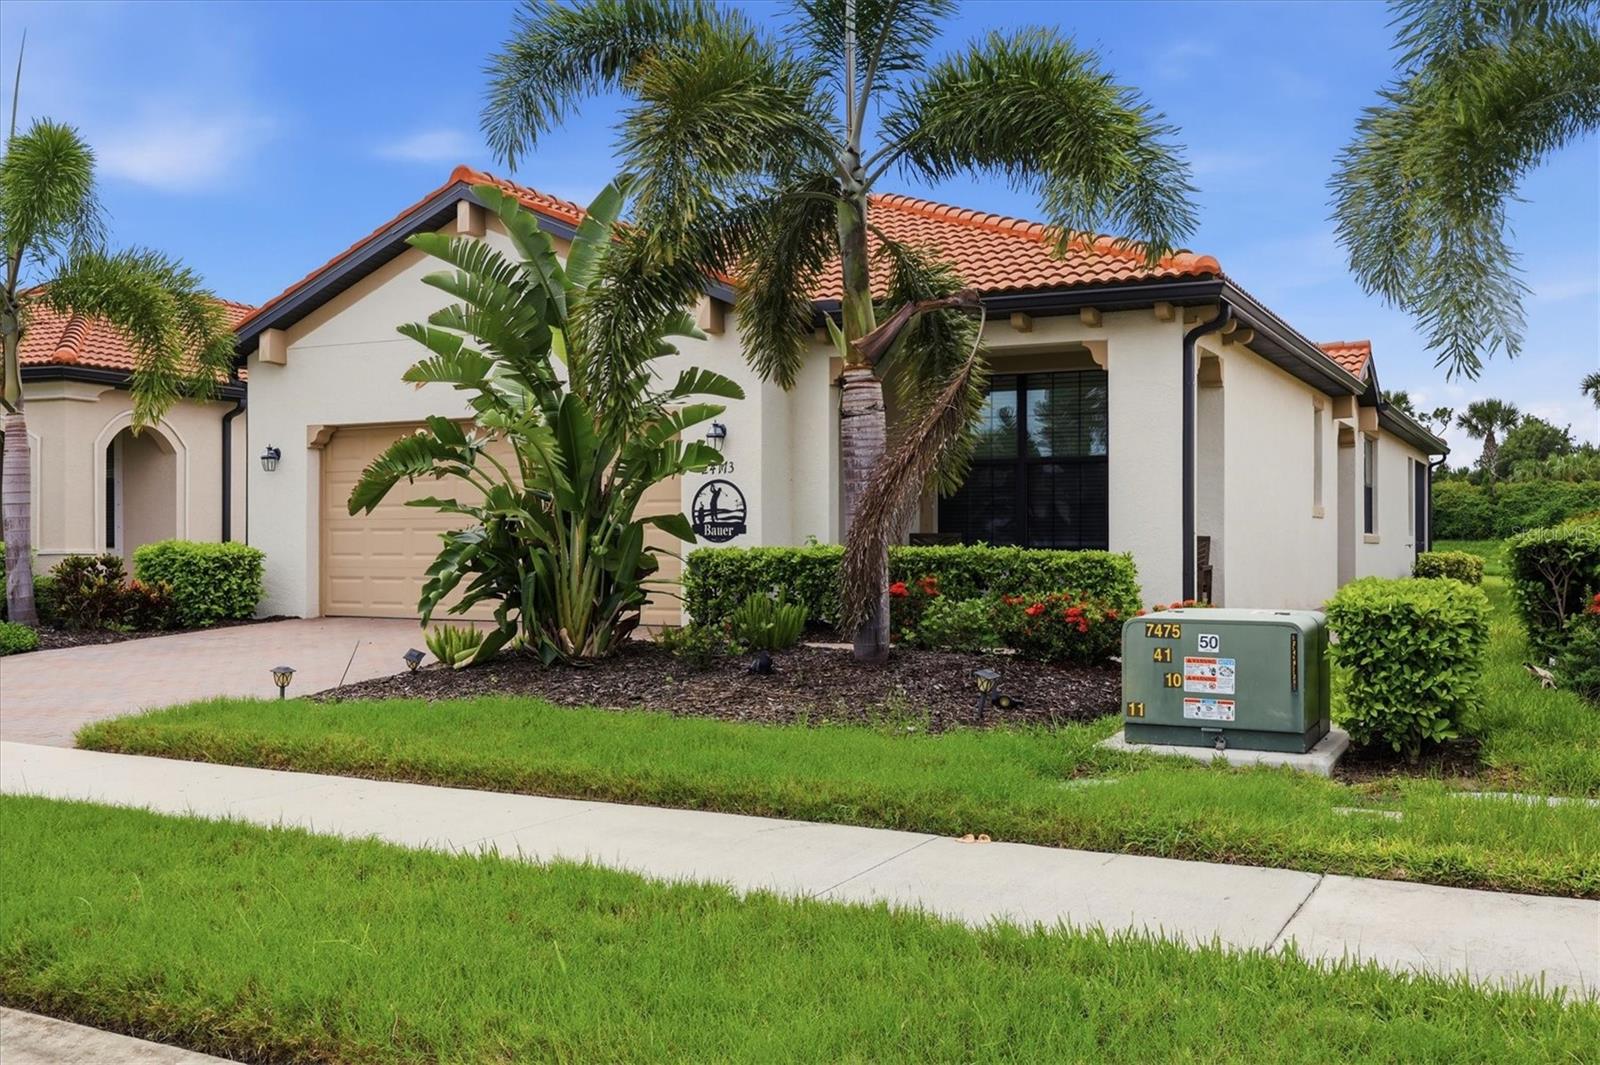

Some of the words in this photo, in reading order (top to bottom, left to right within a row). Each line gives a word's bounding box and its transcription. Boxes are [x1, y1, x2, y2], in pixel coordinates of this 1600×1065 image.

[704, 524, 734, 536] Bauer
[1146, 624, 1181, 638] 7475
[1199, 636, 1218, 649] 50
[1153, 648, 1171, 661] 41
[1166, 673, 1182, 687] 10
[1128, 703, 1144, 716] 11
